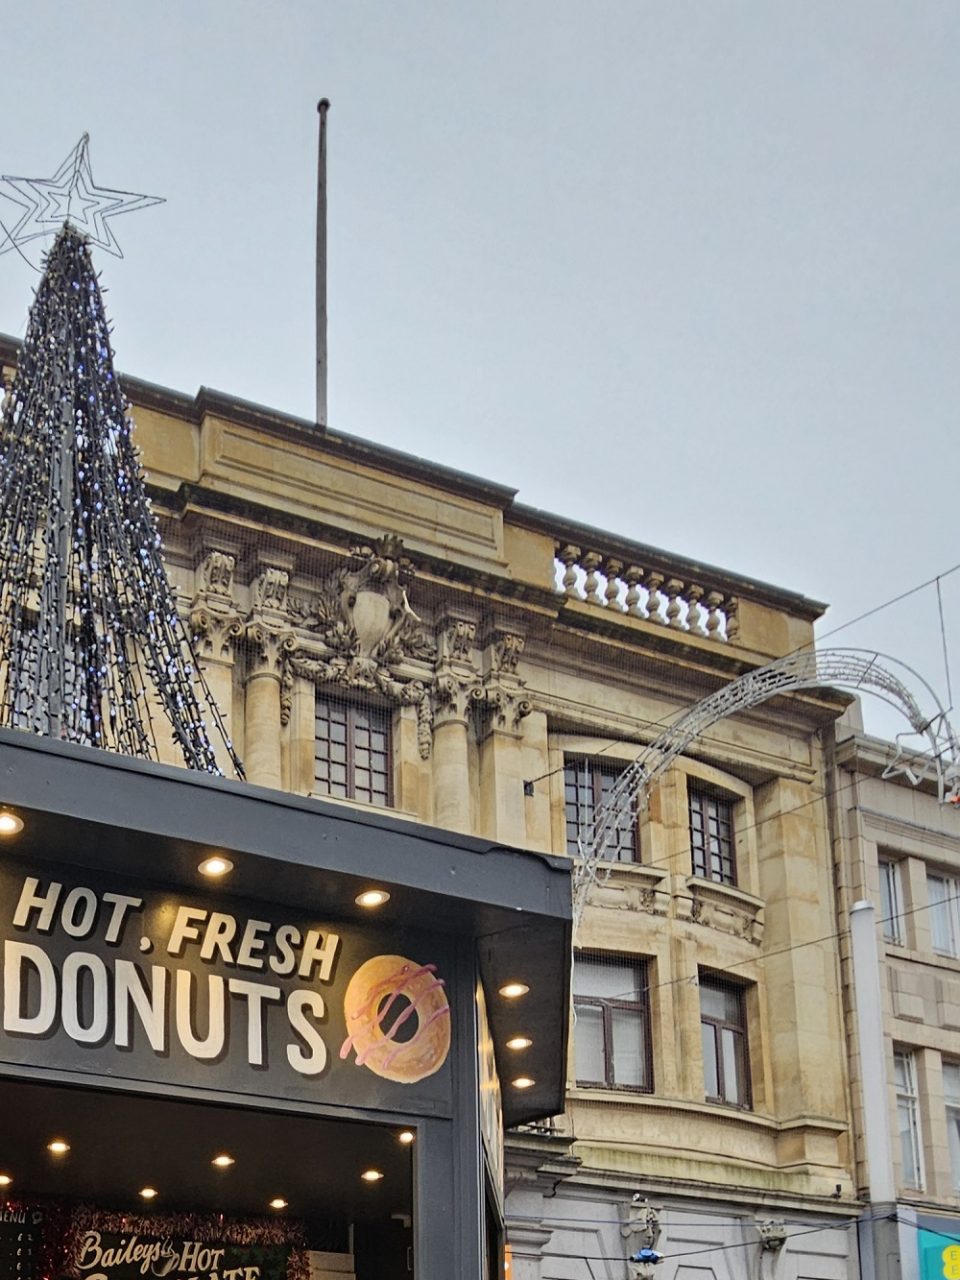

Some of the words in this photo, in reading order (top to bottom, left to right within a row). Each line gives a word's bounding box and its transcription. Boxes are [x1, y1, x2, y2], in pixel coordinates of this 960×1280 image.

[166, 906, 340, 981] FRESH
[3, 939, 327, 1074] DONUTS
[76, 1231, 160, 1275] Baileys
